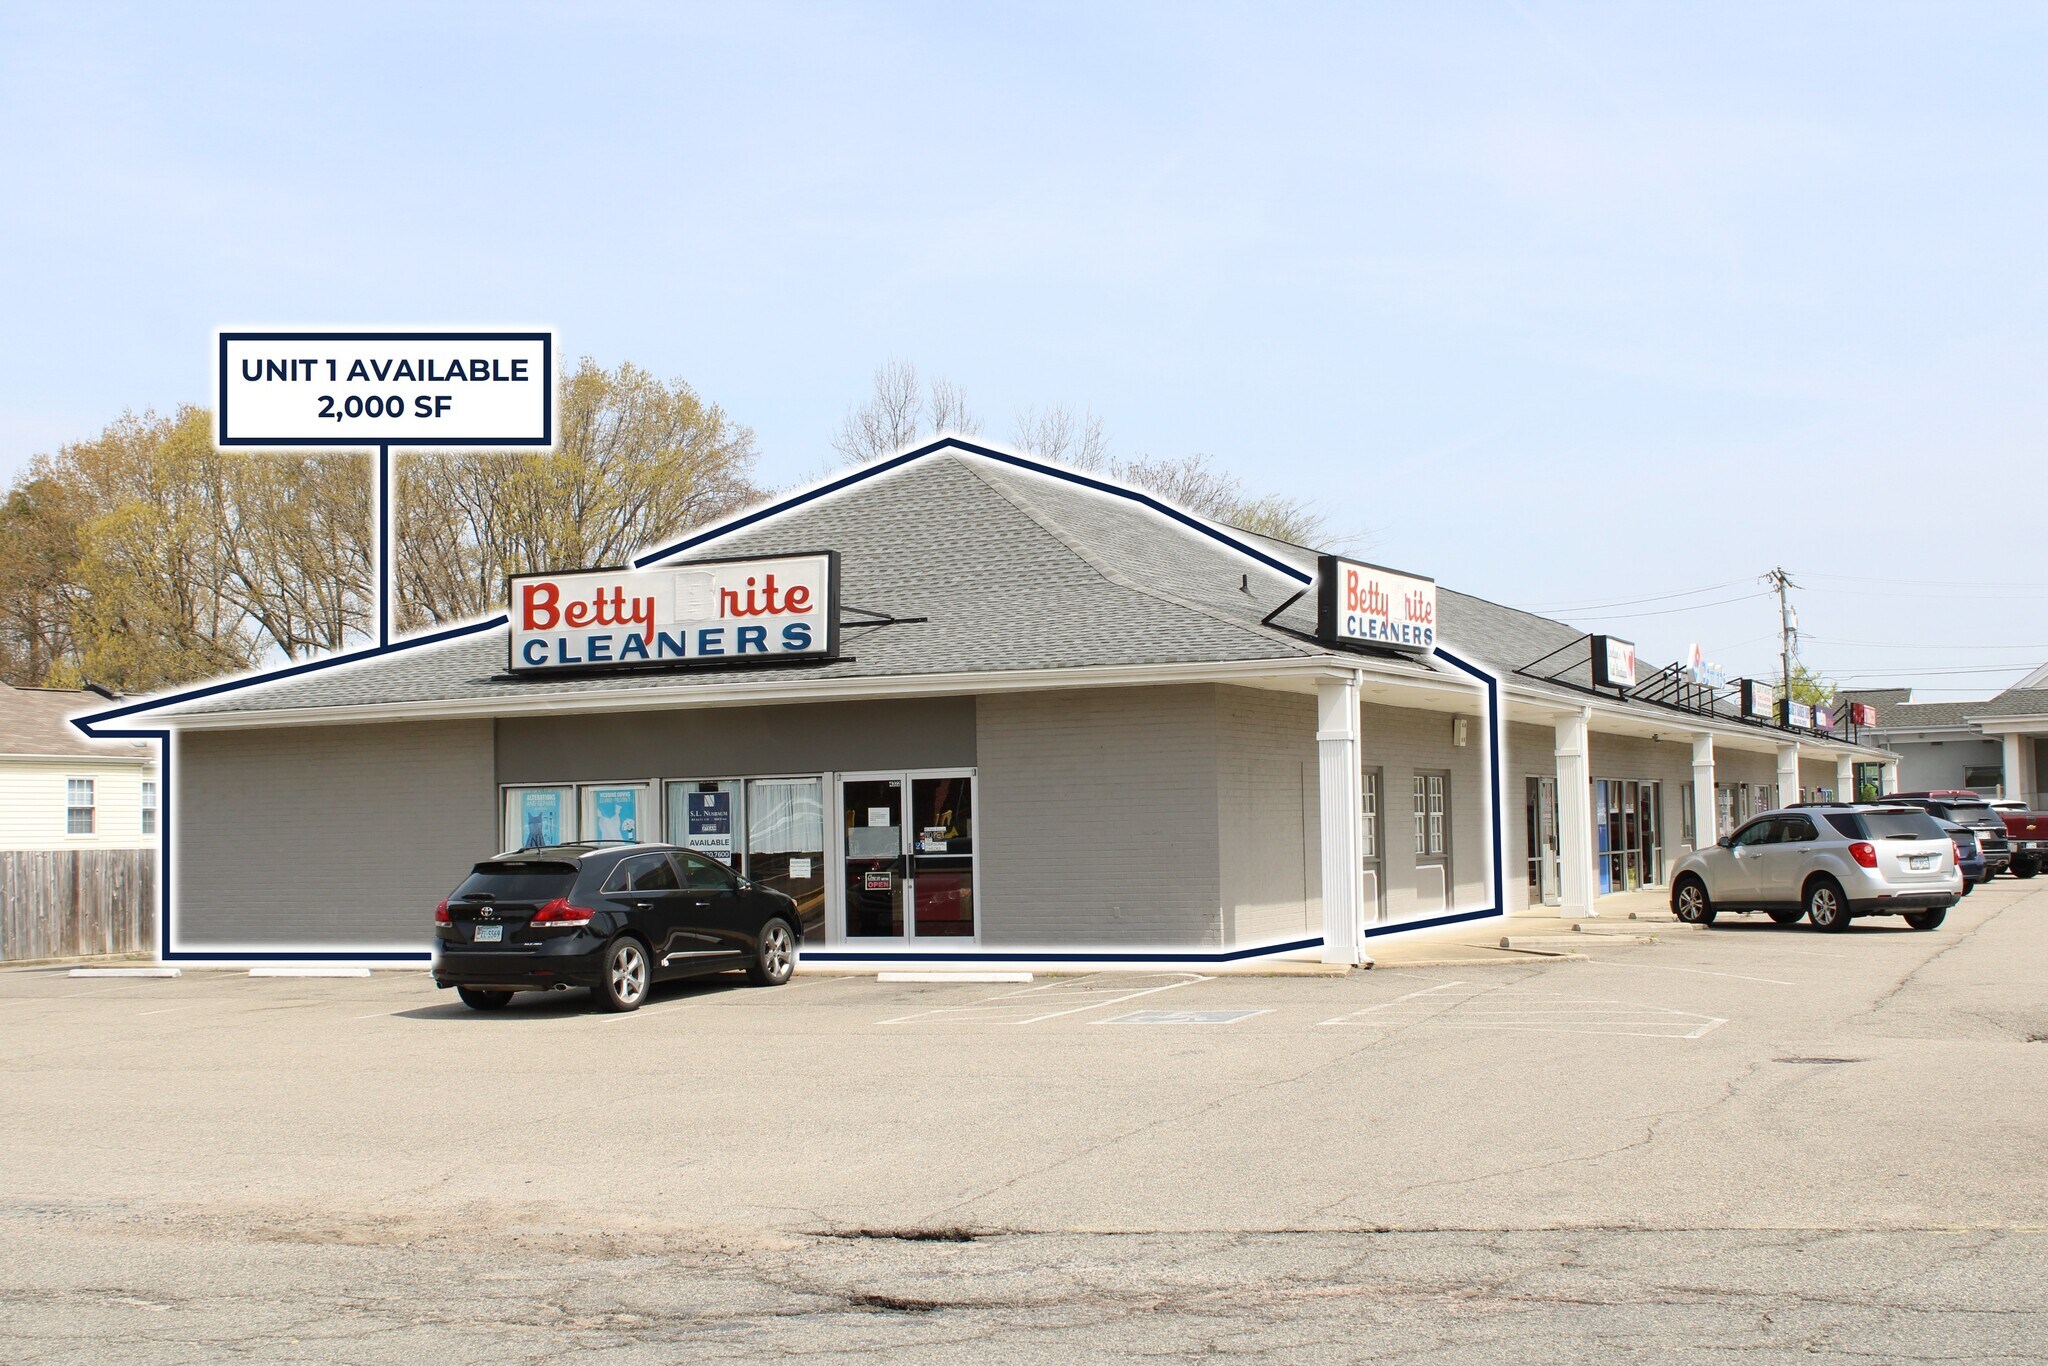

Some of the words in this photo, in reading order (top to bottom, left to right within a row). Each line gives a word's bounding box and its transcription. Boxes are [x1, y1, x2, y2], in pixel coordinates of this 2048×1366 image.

[522, 581, 656, 648] Betty
[1346, 569, 1389, 632] Betty
[522, 621, 813, 666] CLEANERS
[1346, 614, 1433, 646] CLEANERS
[689, 838, 730, 847] AVAILABLE
[867, 881, 889, 889] OPEN
